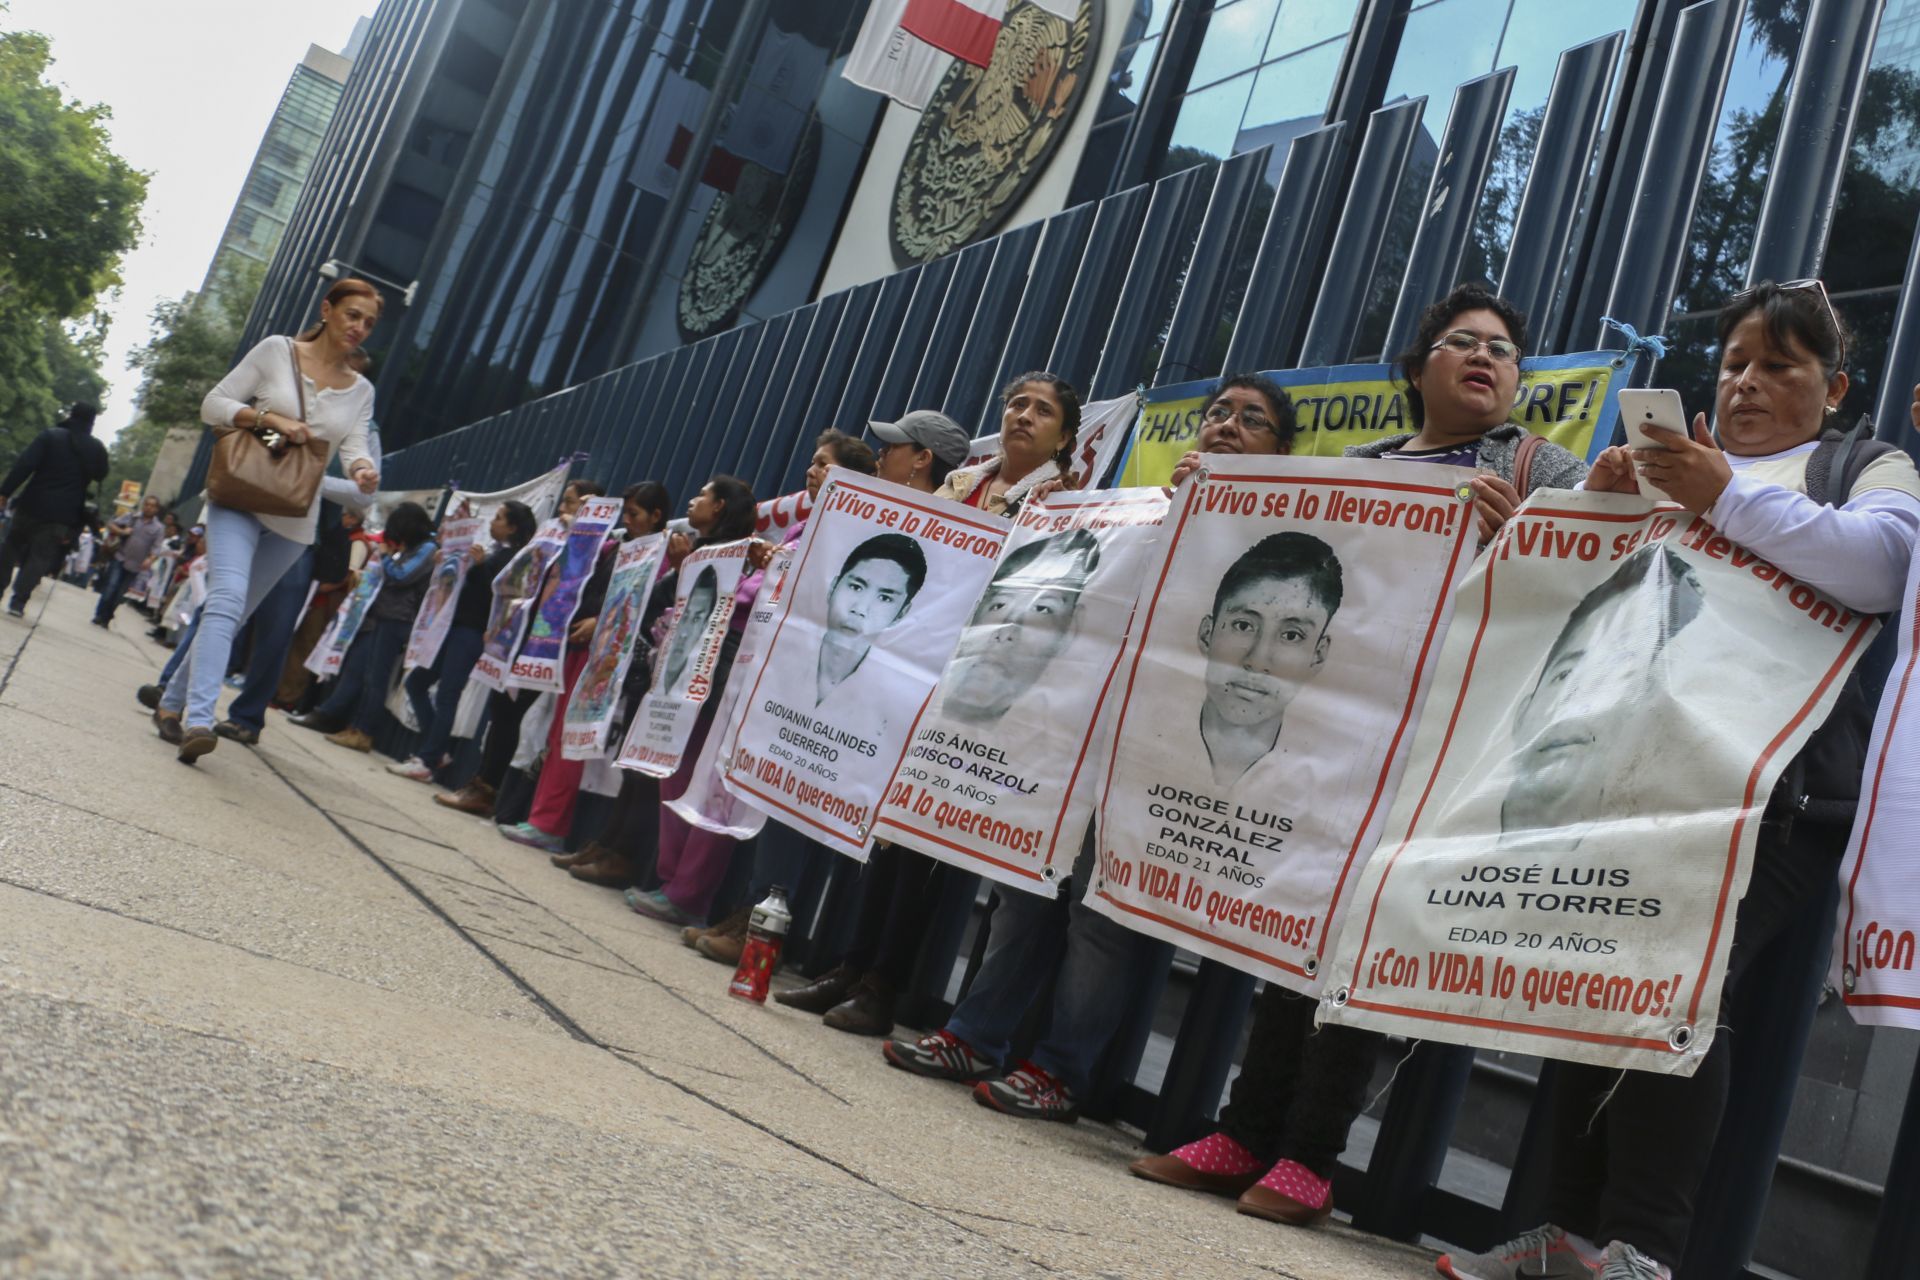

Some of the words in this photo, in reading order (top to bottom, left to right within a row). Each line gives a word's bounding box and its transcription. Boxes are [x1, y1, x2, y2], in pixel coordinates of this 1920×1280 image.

[827, 491, 875, 519] ¡Vivo
[876, 508, 899, 527] se
[899, 511, 920, 533] lo
[1048, 515, 1071, 532] se
[1192, 485, 1257, 516] ¡Vivo
[1261, 492, 1289, 518] se
[1293, 488, 1320, 521] lo
[1324, 490, 1458, 537] llevaron!
[1500, 520, 1601, 561] ¡Vivo
[1610, 525, 1645, 561] se
[1642, 515, 1677, 545] lo
[1680, 515, 1850, 633] llevaron!
[512, 659, 554, 681] están
[764, 700, 813, 731] GIOVANNI
[813, 721, 878, 757] GALINDES
[779, 727, 838, 763] GUERRERO
[918, 729, 946, 744] LUIS
[947, 733, 1009, 765] ÁNGEL
[769, 744, 793, 761] EDAD
[794, 756, 807, 768] 20
[808, 763, 838, 782] AÑOS
[966, 763, 1039, 795] ARZOLA
[734, 748, 755, 772] ¡Con
[756, 757, 783, 789] VIDA
[783, 770, 796, 795] lo
[796, 780, 868, 827] queremos!
[931, 775, 950, 789] 20
[953, 784, 997, 805] AÑOS
[1147, 784, 1229, 815] JORGE
[1235, 806, 1293, 833] LUIS
[912, 789, 934, 816] lo
[935, 801, 1043, 857] queremos!
[1148, 803, 1284, 852] GONZÁLEZ
[1146, 842, 1189, 865] EDAD
[1193, 858, 1210, 873] 21
[1217, 866, 1266, 889] AÑOS
[1159, 827, 1255, 867] PARRAL
[1461, 864, 1544, 884] JOSÉ
[1551, 867, 1630, 888] LUIS
[1104, 850, 1132, 887] ¡Con
[1138, 860, 1181, 904] VIDA
[1182, 876, 1203, 912] lo
[1205, 890, 1316, 950] queremos!
[1427, 889, 1506, 909] LUNA
[1517, 892, 1662, 917] TORRES
[1448, 927, 1508, 946] EDAD
[1515, 932, 1542, 949] 20
[1548, 933, 1618, 955] AÑOS
[1856, 921, 1915, 977] ¡Con
[1366, 947, 1419, 989] ¡Con
[1428, 951, 1484, 996] VIDA
[1490, 957, 1516, 1000] lo
[1522, 966, 1683, 1018] queremos!
